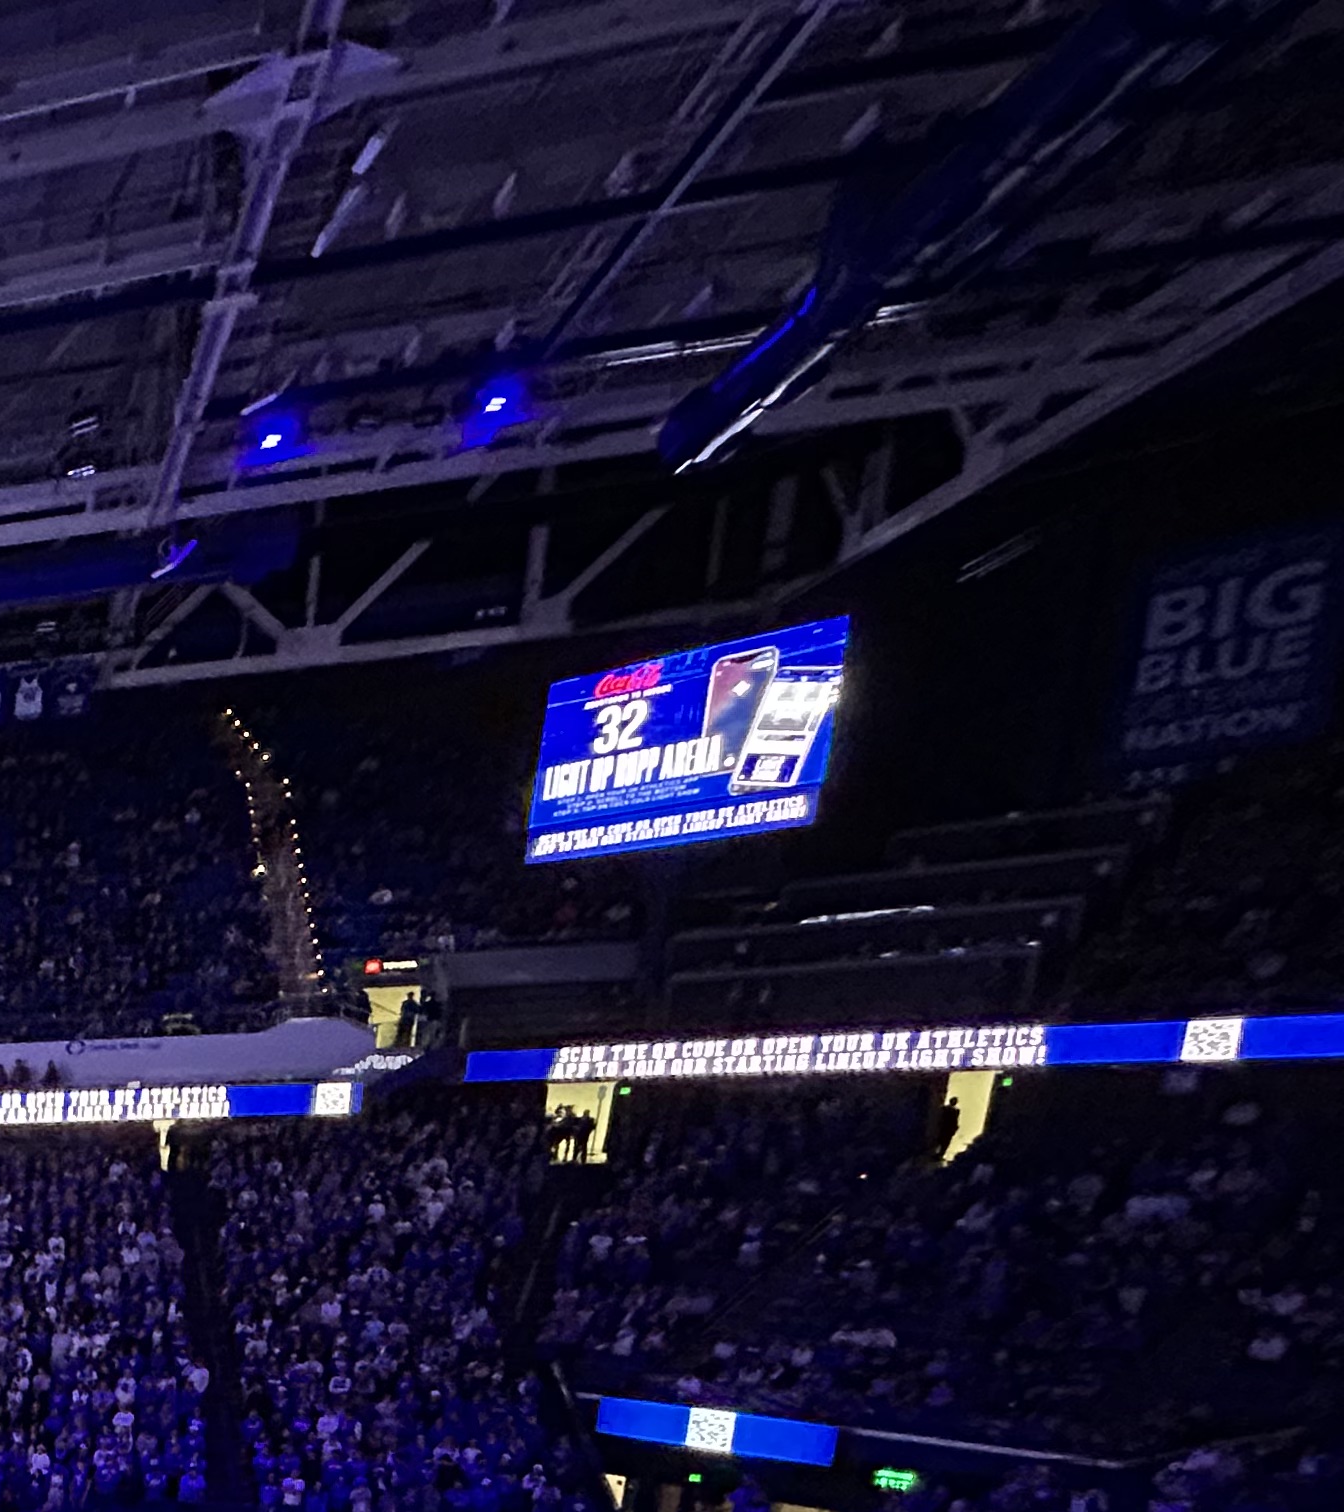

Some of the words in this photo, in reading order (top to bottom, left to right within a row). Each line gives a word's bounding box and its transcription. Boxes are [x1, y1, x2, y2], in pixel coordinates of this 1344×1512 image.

[1142, 560, 1327, 651] BIG
[1135, 623, 1314, 696] BLUE
[592, 700, 647, 753] 32
[543, 759, 590, 800] LIGHT
[588, 754, 614, 792] UP
[613, 746, 660, 788] RUPP
[658, 735, 721, 780] ARENA
[552, 1062, 590, 1079] APP
[593, 1061, 618, 1078] TO
[623, 1059, 667, 1077] JOIN
[670, 1058, 708, 1076] OUR
[712, 1055, 810, 1075] STARTING
[814, 1052, 889, 1072] LINEUP
[897, 1050, 965, 1070] LIGHT
[971, 1047, 1045, 1069] SHOW!
[557, 1044, 605, 1062] SCAN
[608, 1043, 647, 1060] THE
[650, 1042, 678, 1059] QR
[682, 1040, 727, 1058] CODE
[731, 1038, 758, 1056] OR
[762, 1036, 813, 1055] OPEN
[819, 1034, 874, 1053] YOUR
[880, 1032, 911, 1051] UK
[917, 1027, 1042, 1050] ATHLETICS
